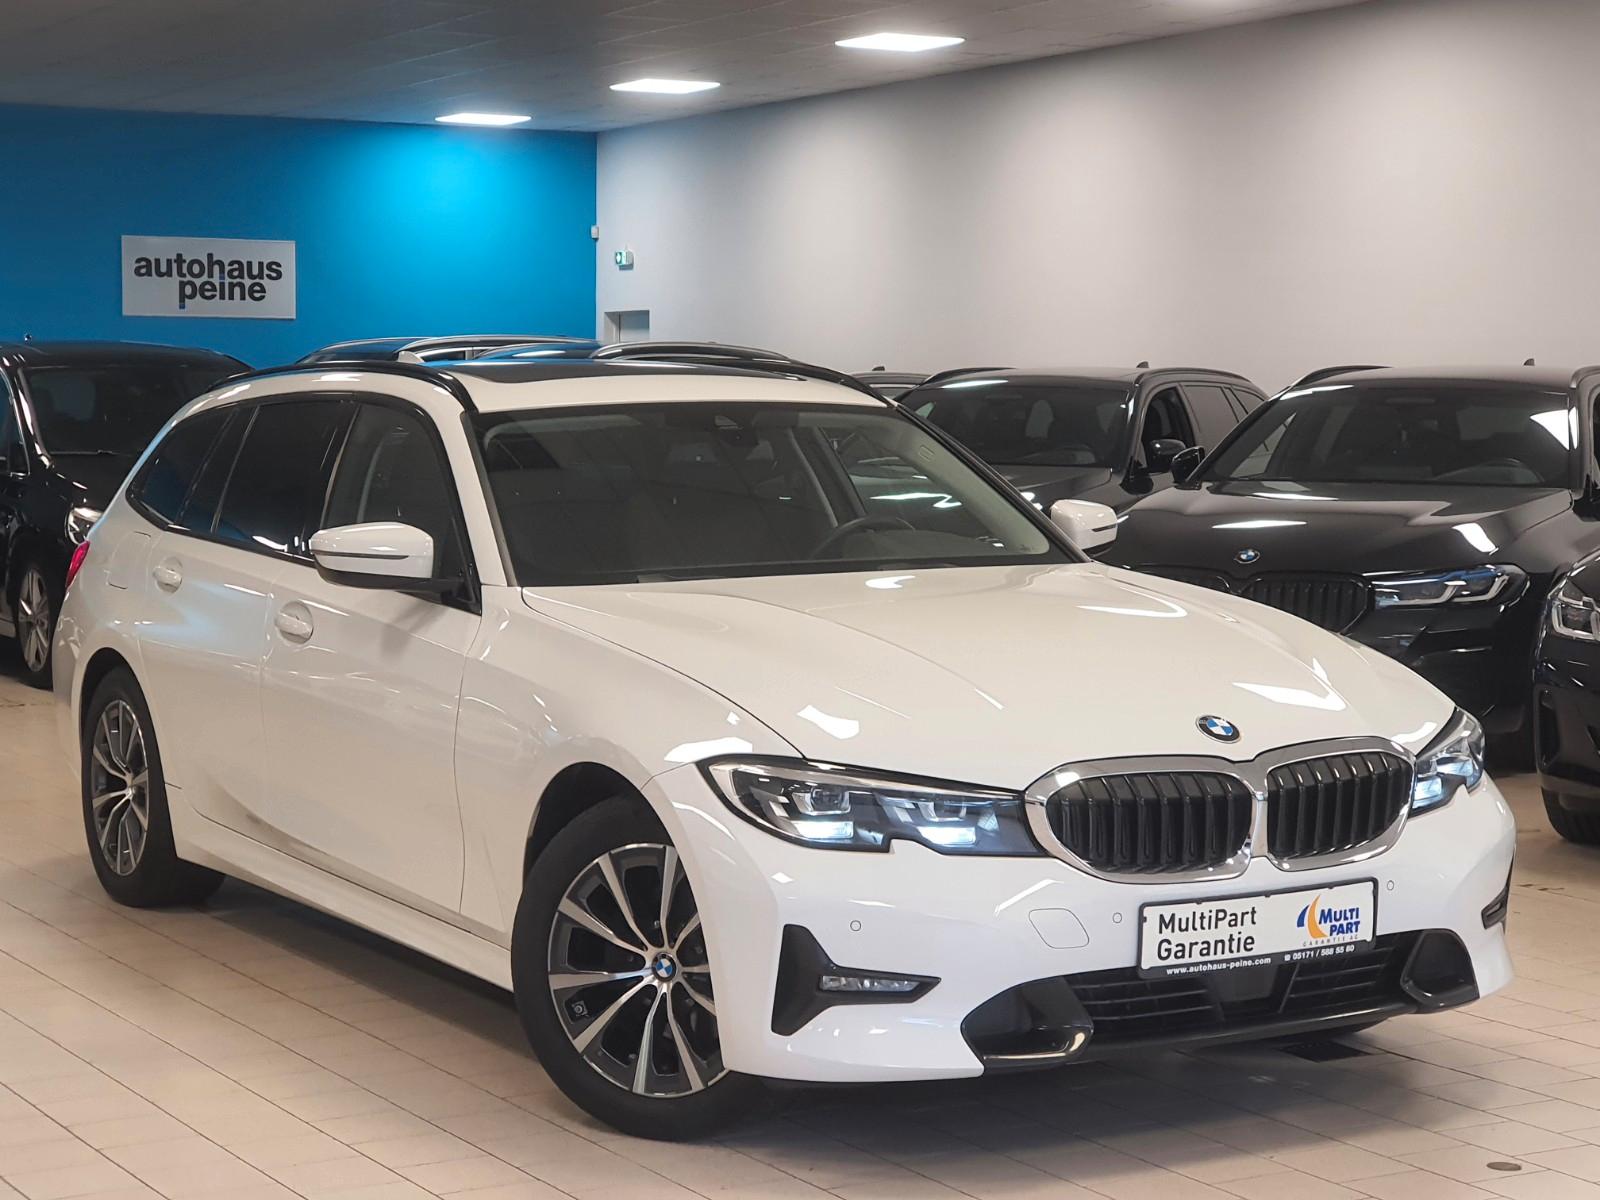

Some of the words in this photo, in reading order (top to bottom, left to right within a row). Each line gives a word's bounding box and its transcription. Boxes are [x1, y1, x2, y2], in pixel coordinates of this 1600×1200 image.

[134, 252, 283, 281] autohaus
[178, 278, 267, 310] peine
[1158, 906, 1257, 934] MultiPart
[1318, 907, 1360, 925] MULTI
[1329, 920, 1361, 936] PART
[1157, 931, 1256, 961] Garantie
[1166, 957, 1272, 975] www.autohaus-peine.com
